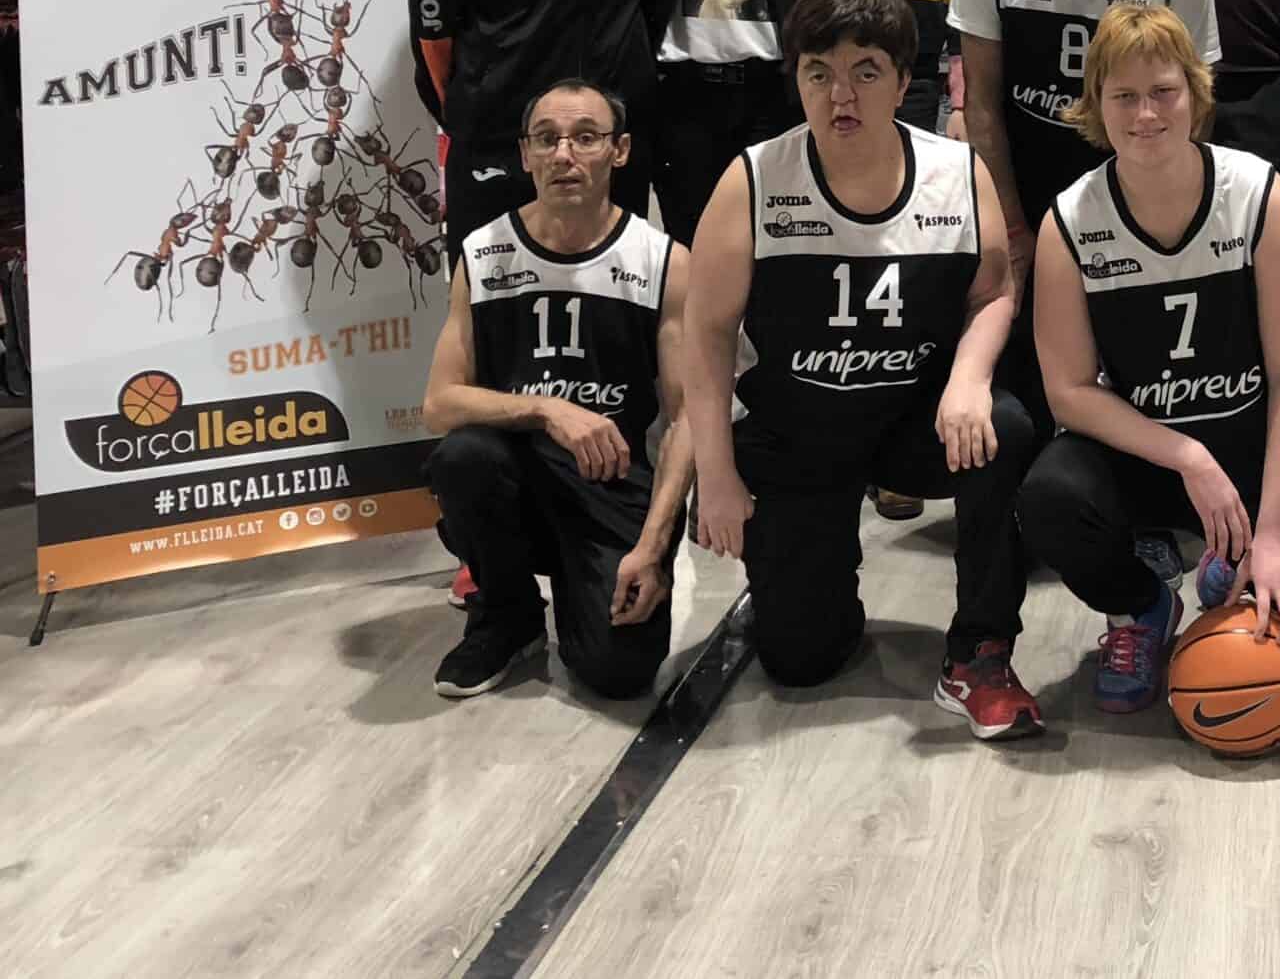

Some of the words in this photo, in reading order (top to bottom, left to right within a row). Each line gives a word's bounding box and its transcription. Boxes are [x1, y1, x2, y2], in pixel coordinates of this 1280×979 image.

[38, 12, 248, 106] AMUNT!
[1059, 23, 1089, 78] 8
[925, 215, 962, 227] ASPROS
[828, 262, 904, 327] 14
[227, 316, 412, 377] SUMA-T'HI!
[532, 296, 585, 359] 11
[1163, 292, 1198, 361] 7
[95, 400, 328, 469] forçalleida
[153, 463, 351, 516] #FORÇALLEIDA
